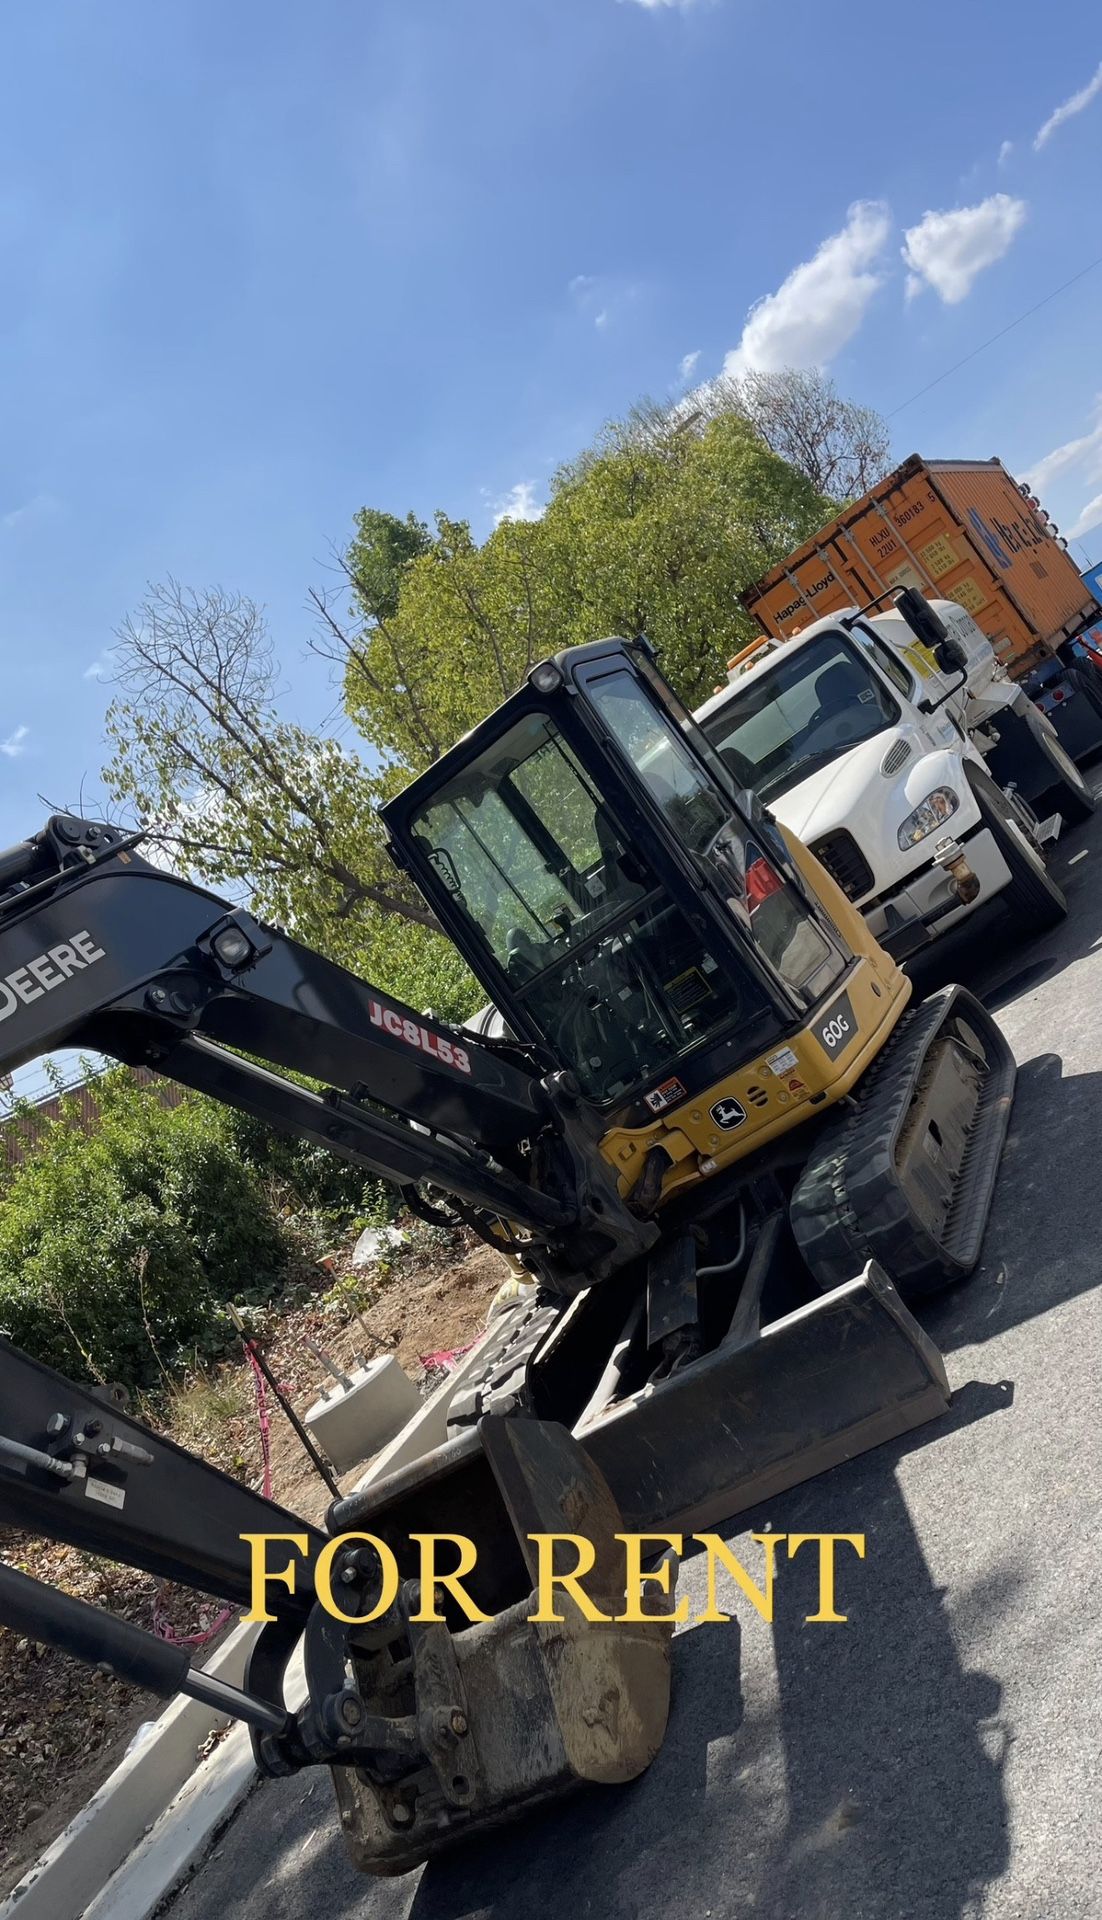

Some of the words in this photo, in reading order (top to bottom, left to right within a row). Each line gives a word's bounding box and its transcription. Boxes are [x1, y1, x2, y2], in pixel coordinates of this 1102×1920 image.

[869, 527, 891, 547] HLXU
[895, 501, 925, 528] 360183
[928, 492, 936, 504] 5
[773, 571, 835, 624] Hapag-Lloyd
[0, 930, 106, 1021] DEERE
[369, 1000, 471, 1074] JC8L53
[822, 1014, 850, 1048] 60G
